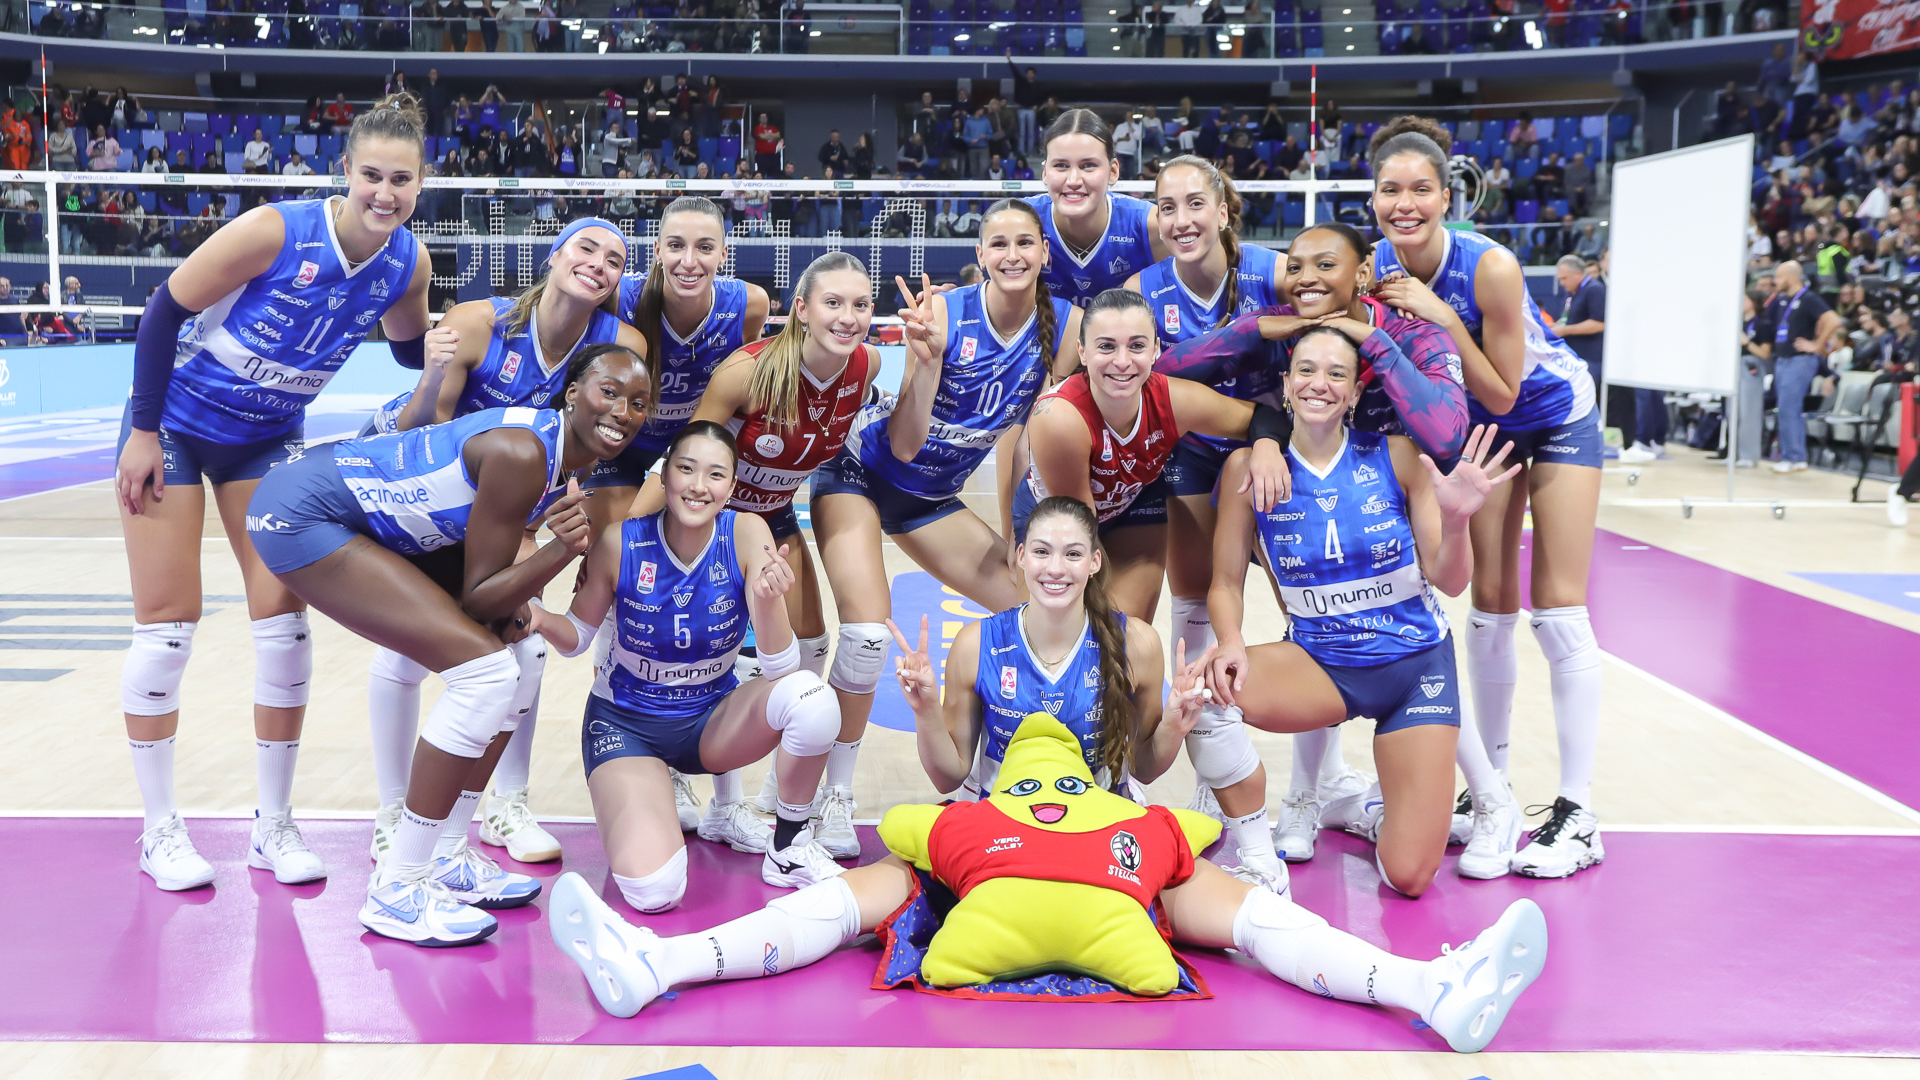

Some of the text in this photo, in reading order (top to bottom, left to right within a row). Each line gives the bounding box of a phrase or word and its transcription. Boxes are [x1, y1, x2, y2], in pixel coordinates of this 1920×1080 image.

[270, 288, 312, 309] FREDDY
[264, 305, 288, 322] ASUS
[253, 320, 282, 341] SYM
[294, 315, 334, 355] 11
[239, 326, 276, 355] GigaTera
[270, 370, 324, 388] numia
[660, 372, 690, 394] 25
[232, 384, 301, 411] CONTECO
[481, 382, 517, 405] FREDDY
[936, 392, 959, 407] SYM
[972, 380, 1004, 417] 10
[793, 433, 816, 466] 7
[1361, 501, 1390, 514] MORO
[1267, 512, 1306, 522] FREDDY
[1364, 518, 1398, 533] KGM
[1324, 518, 1345, 564] 4
[1279, 556, 1306, 569] SYM
[1331, 581, 1393, 606] numia
[623, 597, 662, 613] FREDDY
[624, 617, 646, 630] ASUS
[674, 613, 691, 649] 5
[708, 614, 739, 633] KGM
[626, 634, 654, 648] SYM
[1351, 631, 1378, 641] LABO
[665, 662, 722, 679] numia
[800, 684, 825, 701] FREDDY
[989, 703, 1028, 719] FREDDY
[1406, 705, 1453, 715] FREDDY
[593, 735, 621, 748] SKIN
[594, 742, 623, 756] LABO
[985, 841, 1024, 854] VOLLEY
[993, 836, 1021, 845] VERO
